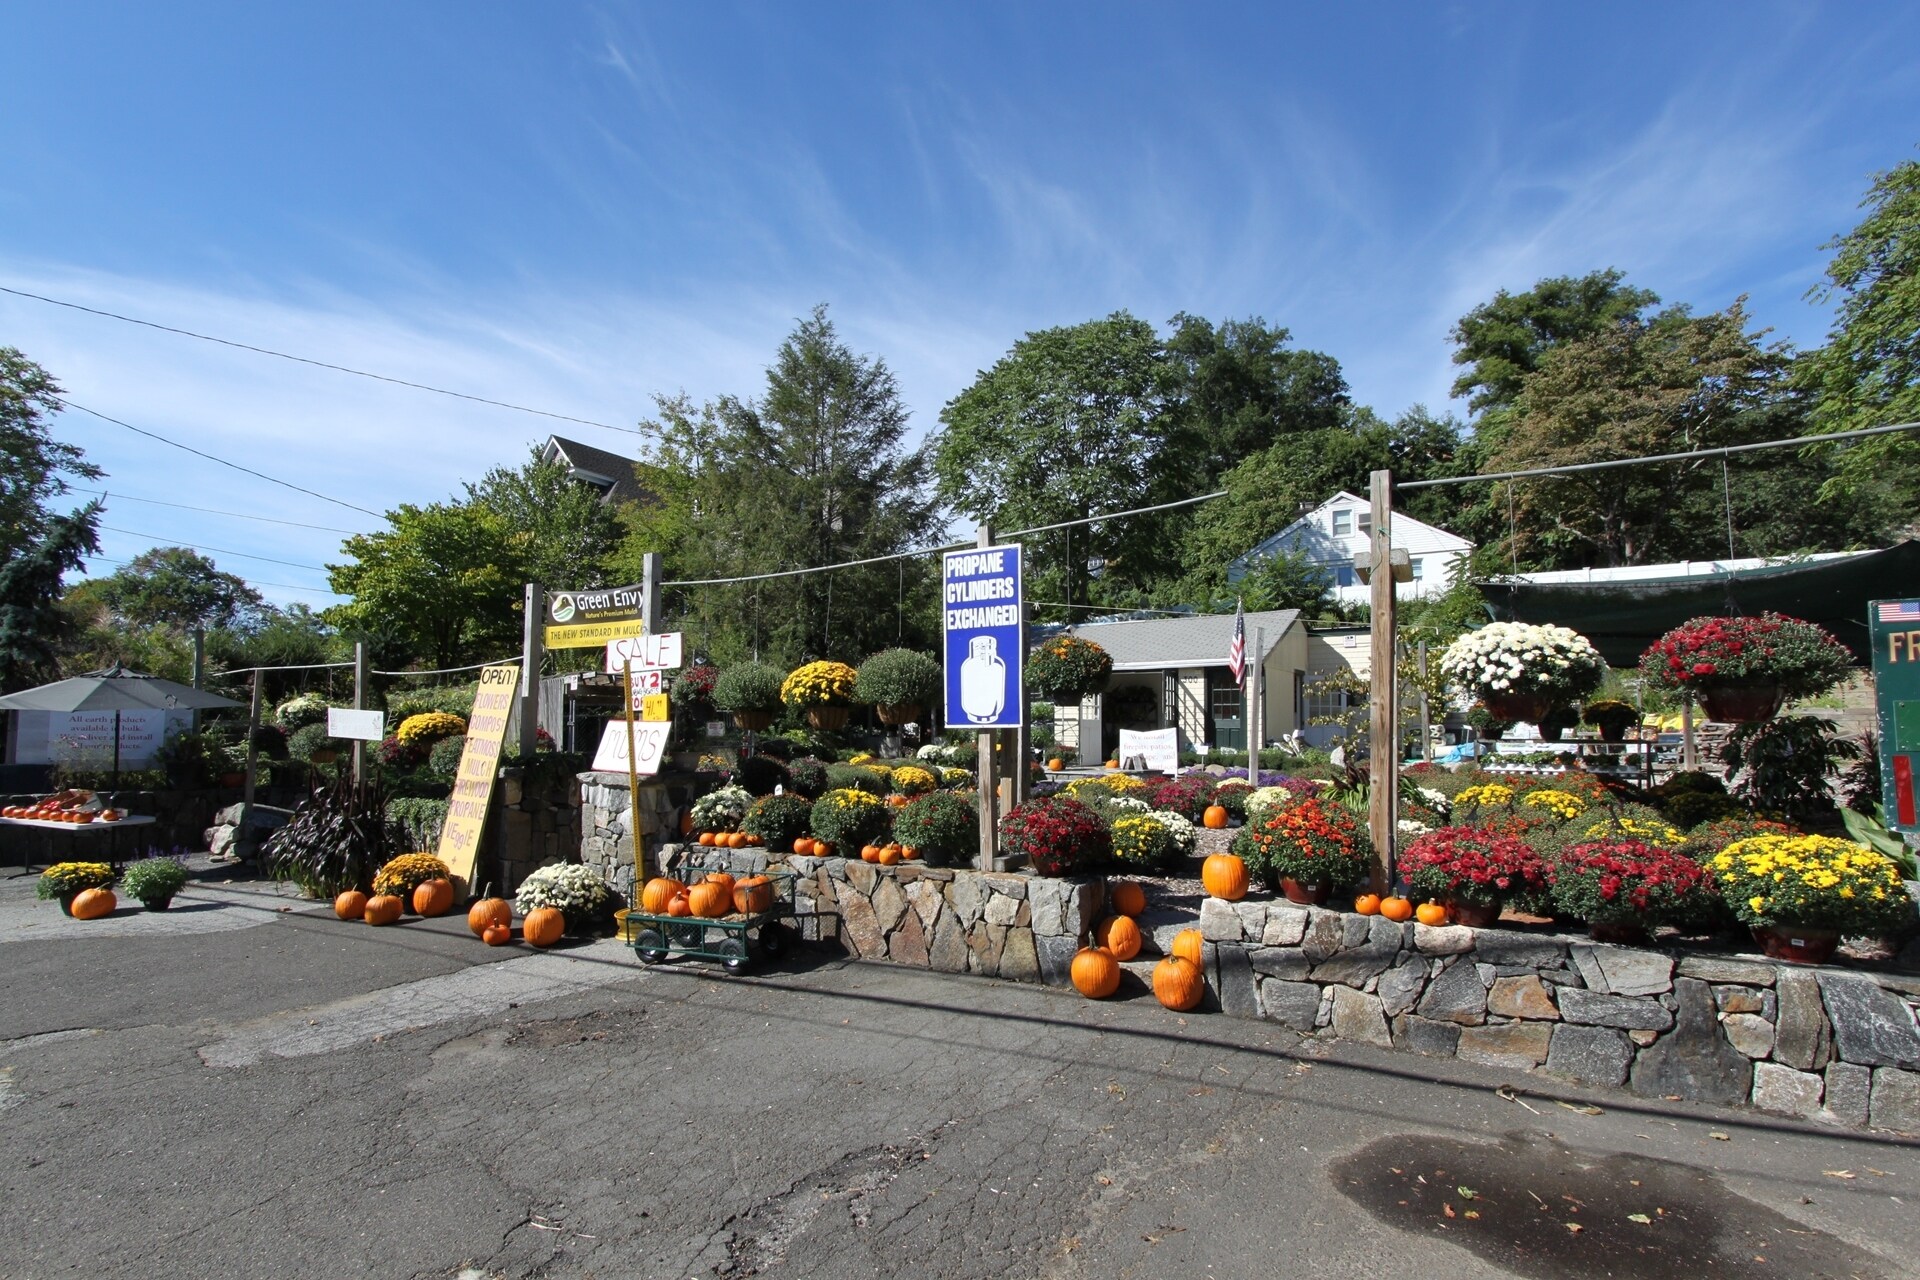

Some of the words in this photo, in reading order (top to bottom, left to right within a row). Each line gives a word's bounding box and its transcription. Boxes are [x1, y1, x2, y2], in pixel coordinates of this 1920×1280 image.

[947, 552, 1004, 578] PROPANE
[576, 593, 611, 611] Green
[613, 590, 643, 609] Envy
[947, 577, 1015, 604] CYLINDERS
[585, 611, 603, 619] Nature's
[624, 607, 638, 615] Mulch
[947, 604, 1018, 630] EXCHANGED
[551, 631, 561, 640] THE
[563, 629, 577, 639] NEW
[580, 627, 612, 638] STANDARD
[614, 627, 621, 636] IN
[612, 635, 671, 672] SALE
[481, 669, 516, 685] OPEN!
[650, 672, 660, 688] 2
[474, 692, 509, 710] FLOWERS
[470, 714, 506, 733] COMPOST
[465, 737, 501, 759] EATMOSS
[465, 758, 494, 777] MULCH
[449, 799, 486, 820] PROPANE
